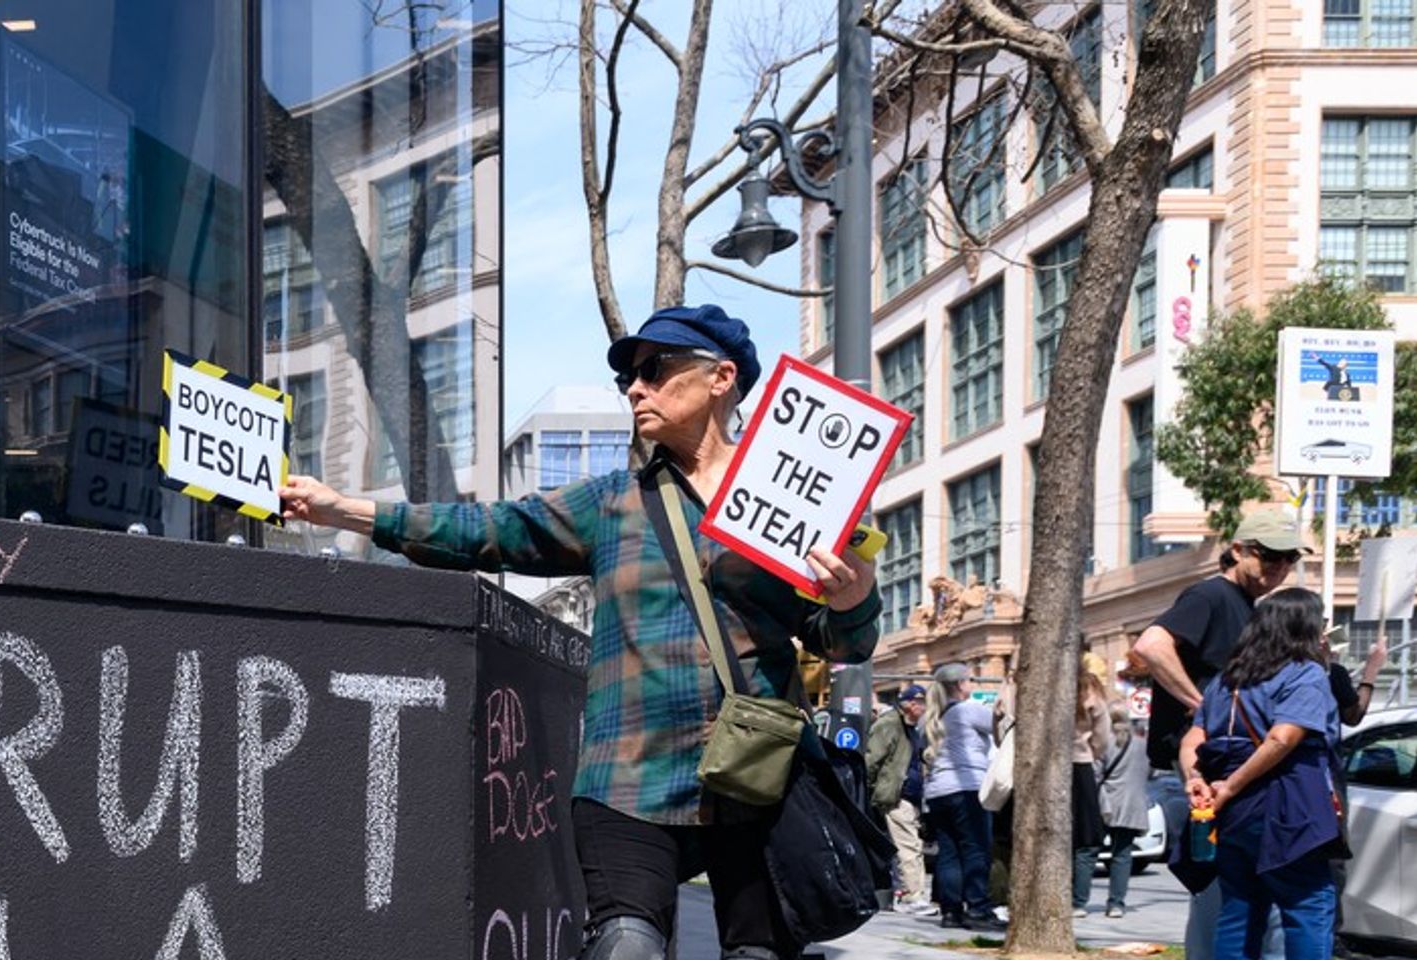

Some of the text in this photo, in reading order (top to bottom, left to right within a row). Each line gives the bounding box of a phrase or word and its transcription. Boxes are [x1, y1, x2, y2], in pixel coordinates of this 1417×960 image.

[10, 211, 65, 252] Cybertruck
[10, 231, 45, 261] Eligible
[48, 249, 61, 268] for
[49, 268, 65, 290] Tax
[178, 383, 279, 441] BOYCOTT
[773, 387, 881, 460] STOP
[179, 425, 274, 491] TESLA
[772, 451, 833, 506] THE
